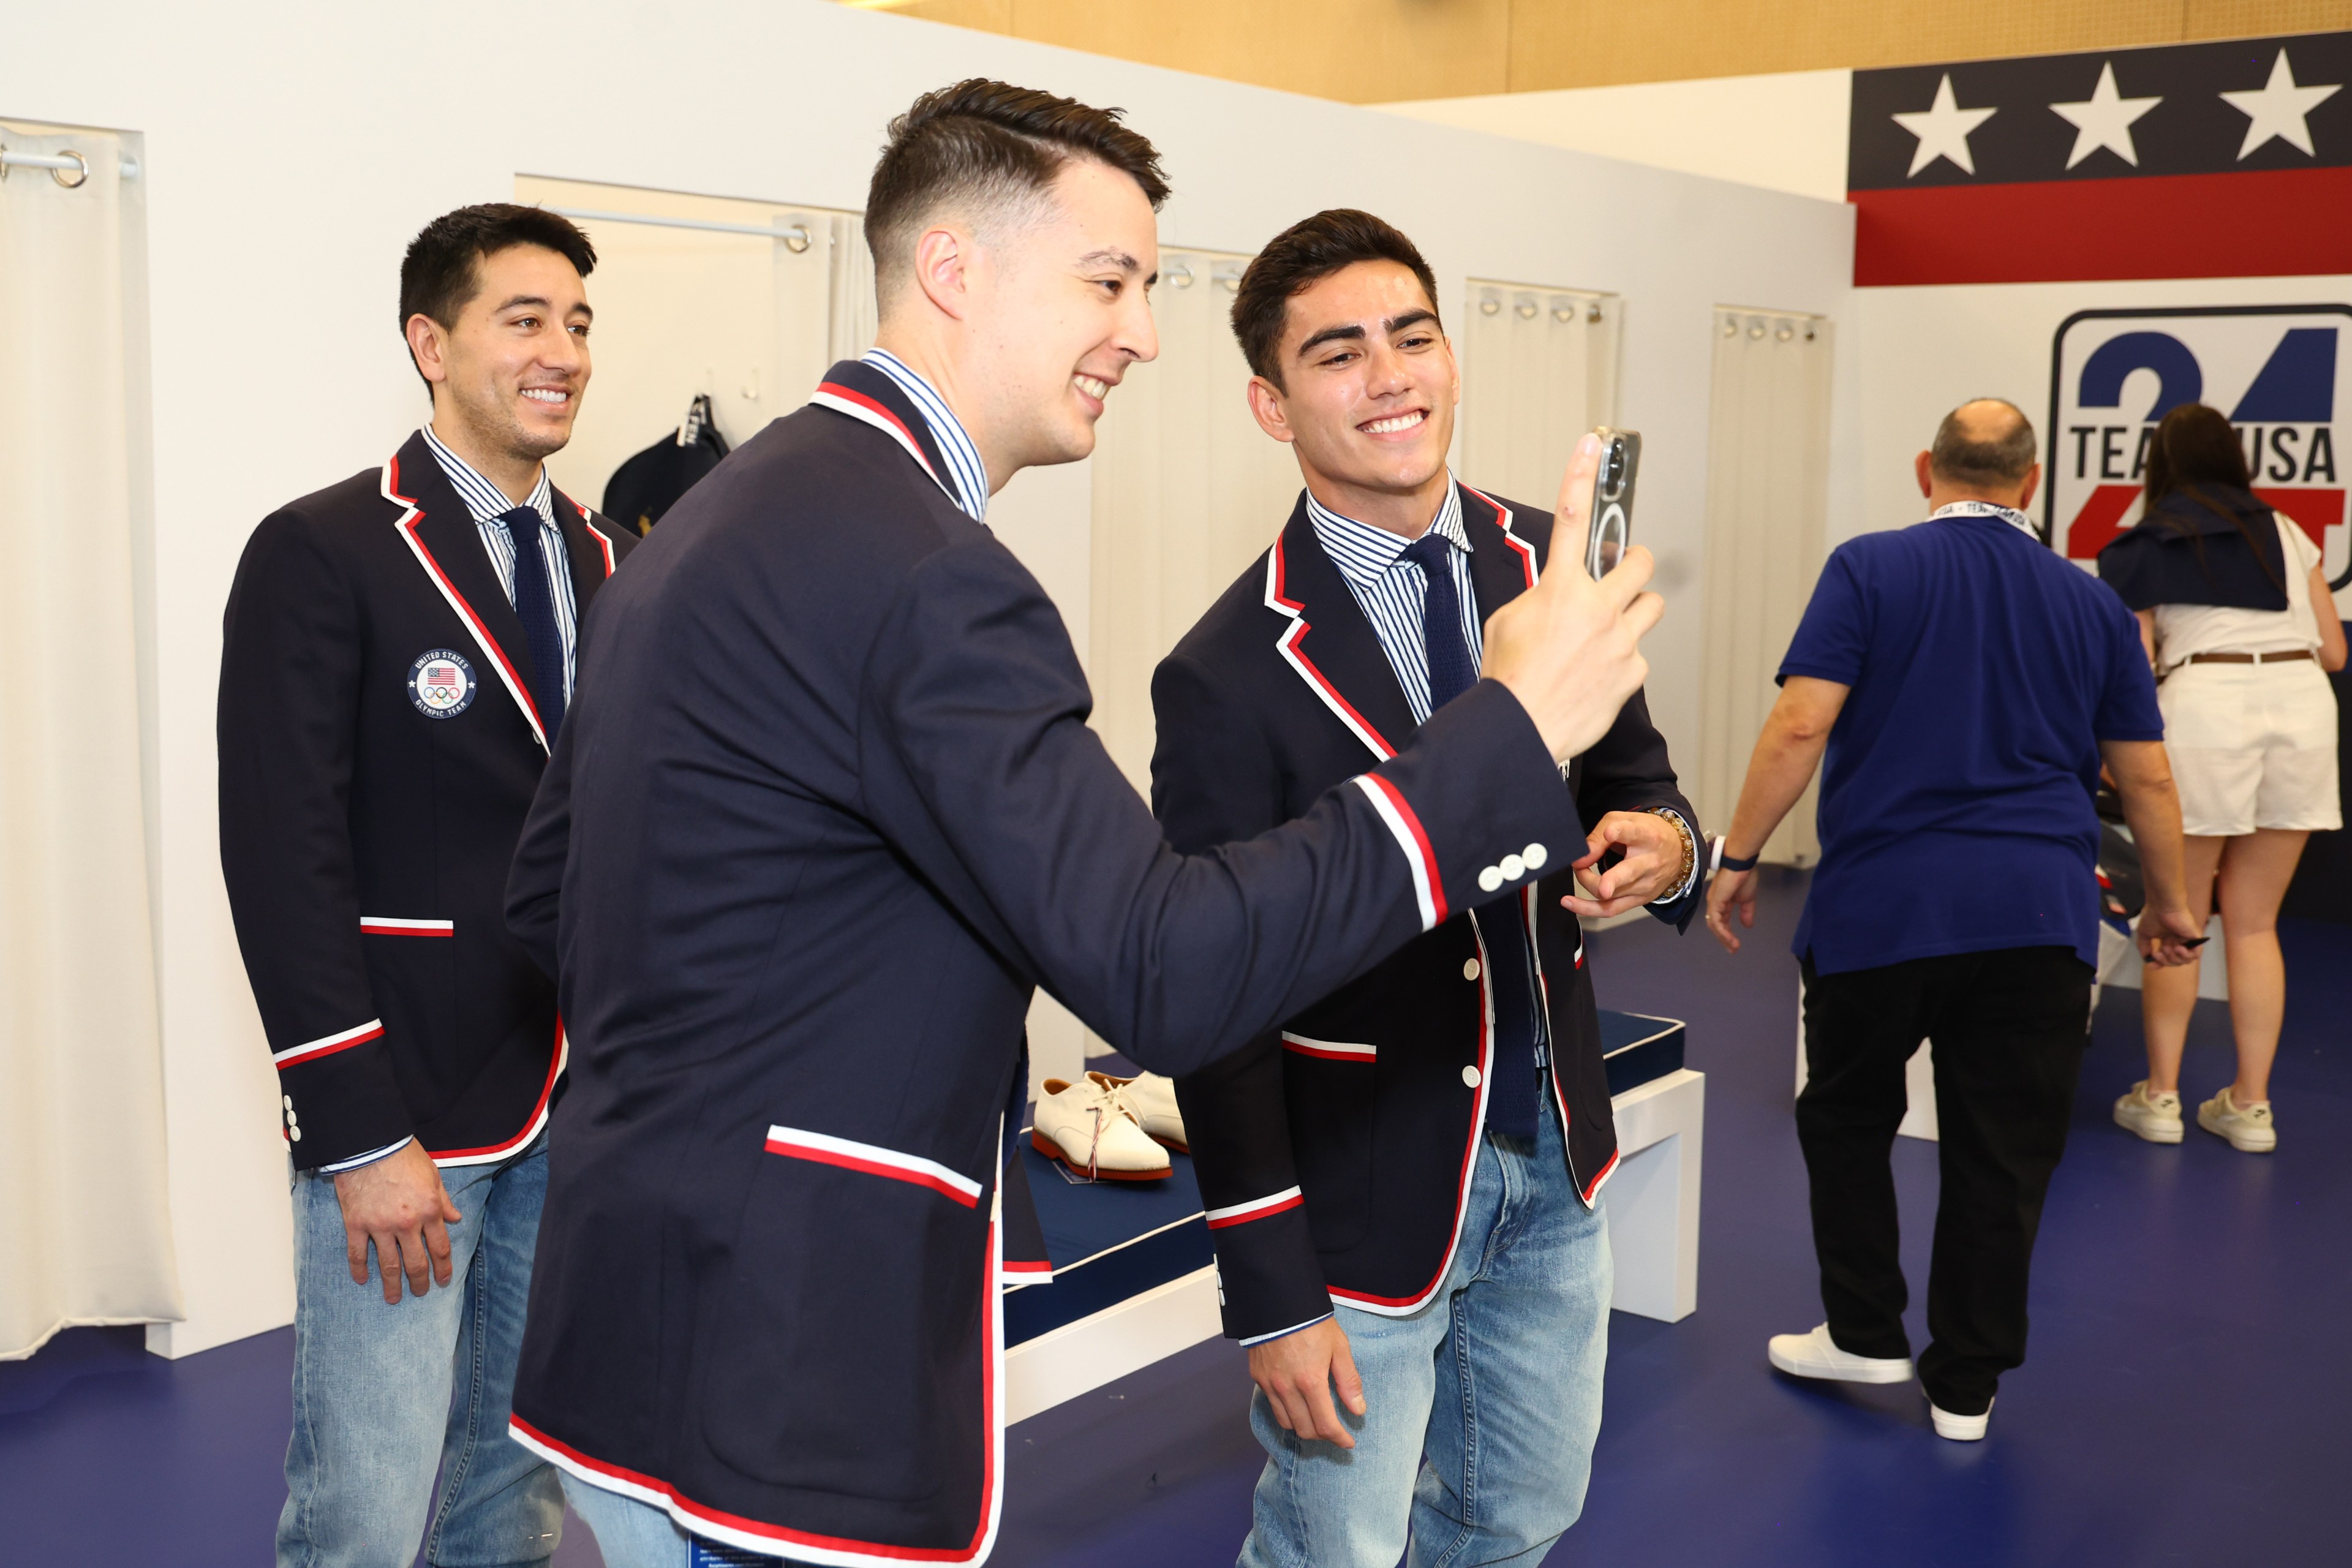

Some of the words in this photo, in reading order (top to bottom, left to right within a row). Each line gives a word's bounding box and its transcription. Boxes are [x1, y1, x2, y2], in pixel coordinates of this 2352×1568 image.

[2069, 426, 2154, 480] TEA
[2236, 426, 2337, 483] USA
[415, 651, 440, 669] UNITED
[442, 651, 469, 669] STATES
[415, 699, 444, 717] OLYMPIC
[447, 701, 467, 715] TEAM
